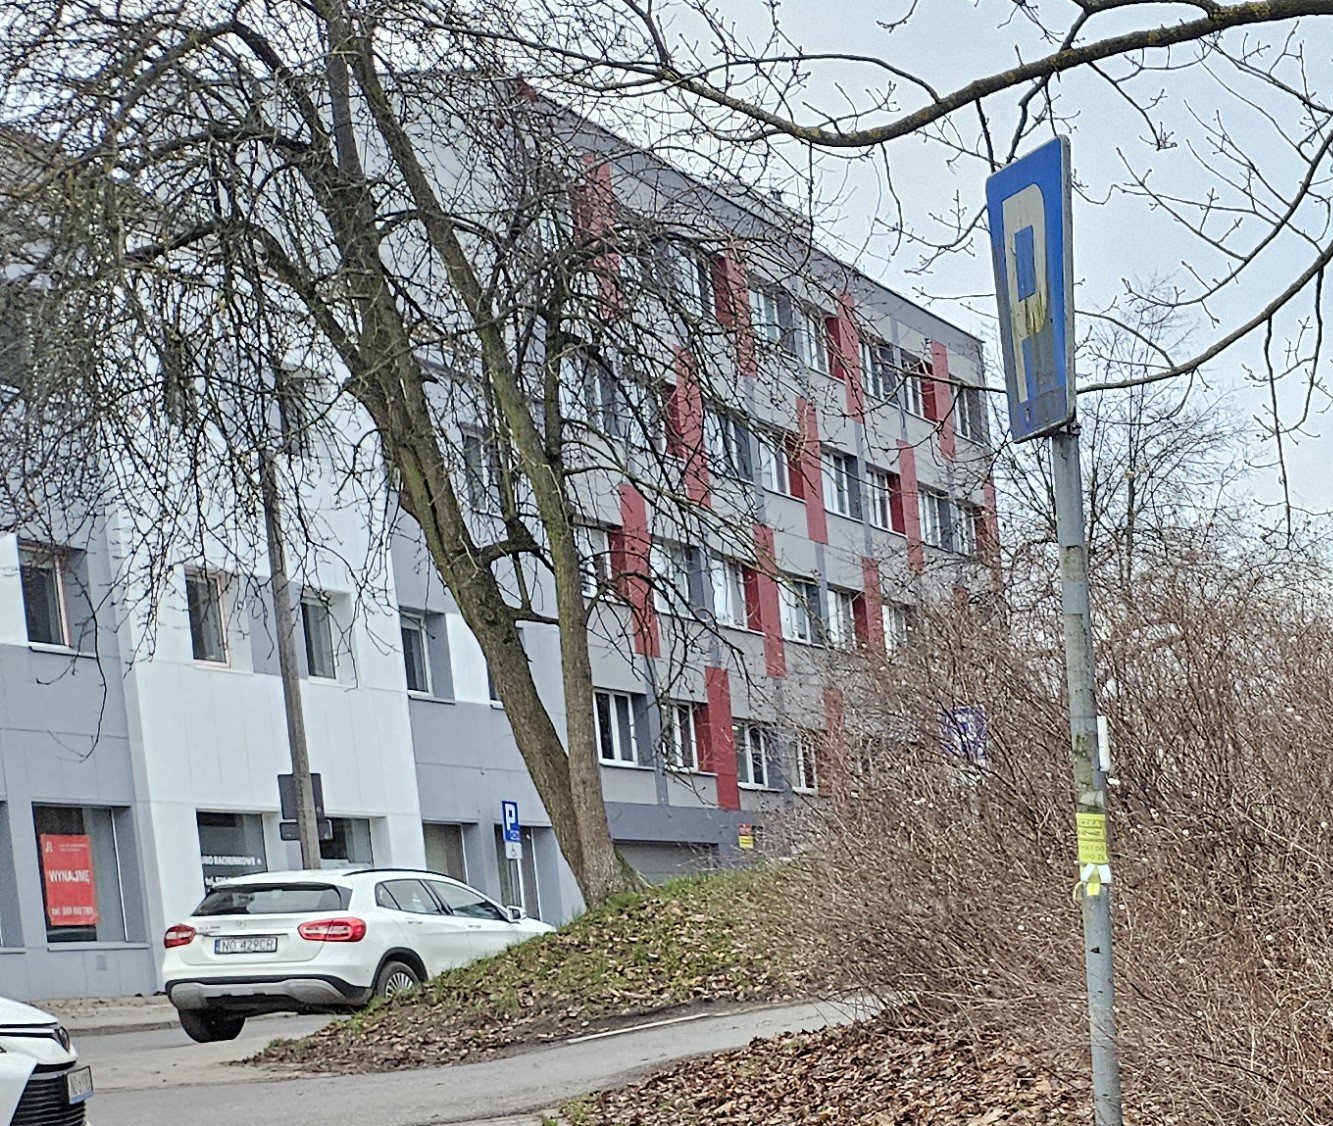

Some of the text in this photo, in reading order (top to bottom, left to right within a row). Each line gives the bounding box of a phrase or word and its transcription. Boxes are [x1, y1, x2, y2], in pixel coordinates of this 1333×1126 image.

[1002, 183, 1047, 403] P
[505, 803, 516, 831] P
[49, 869, 90, 885] WYNAJMĘ
